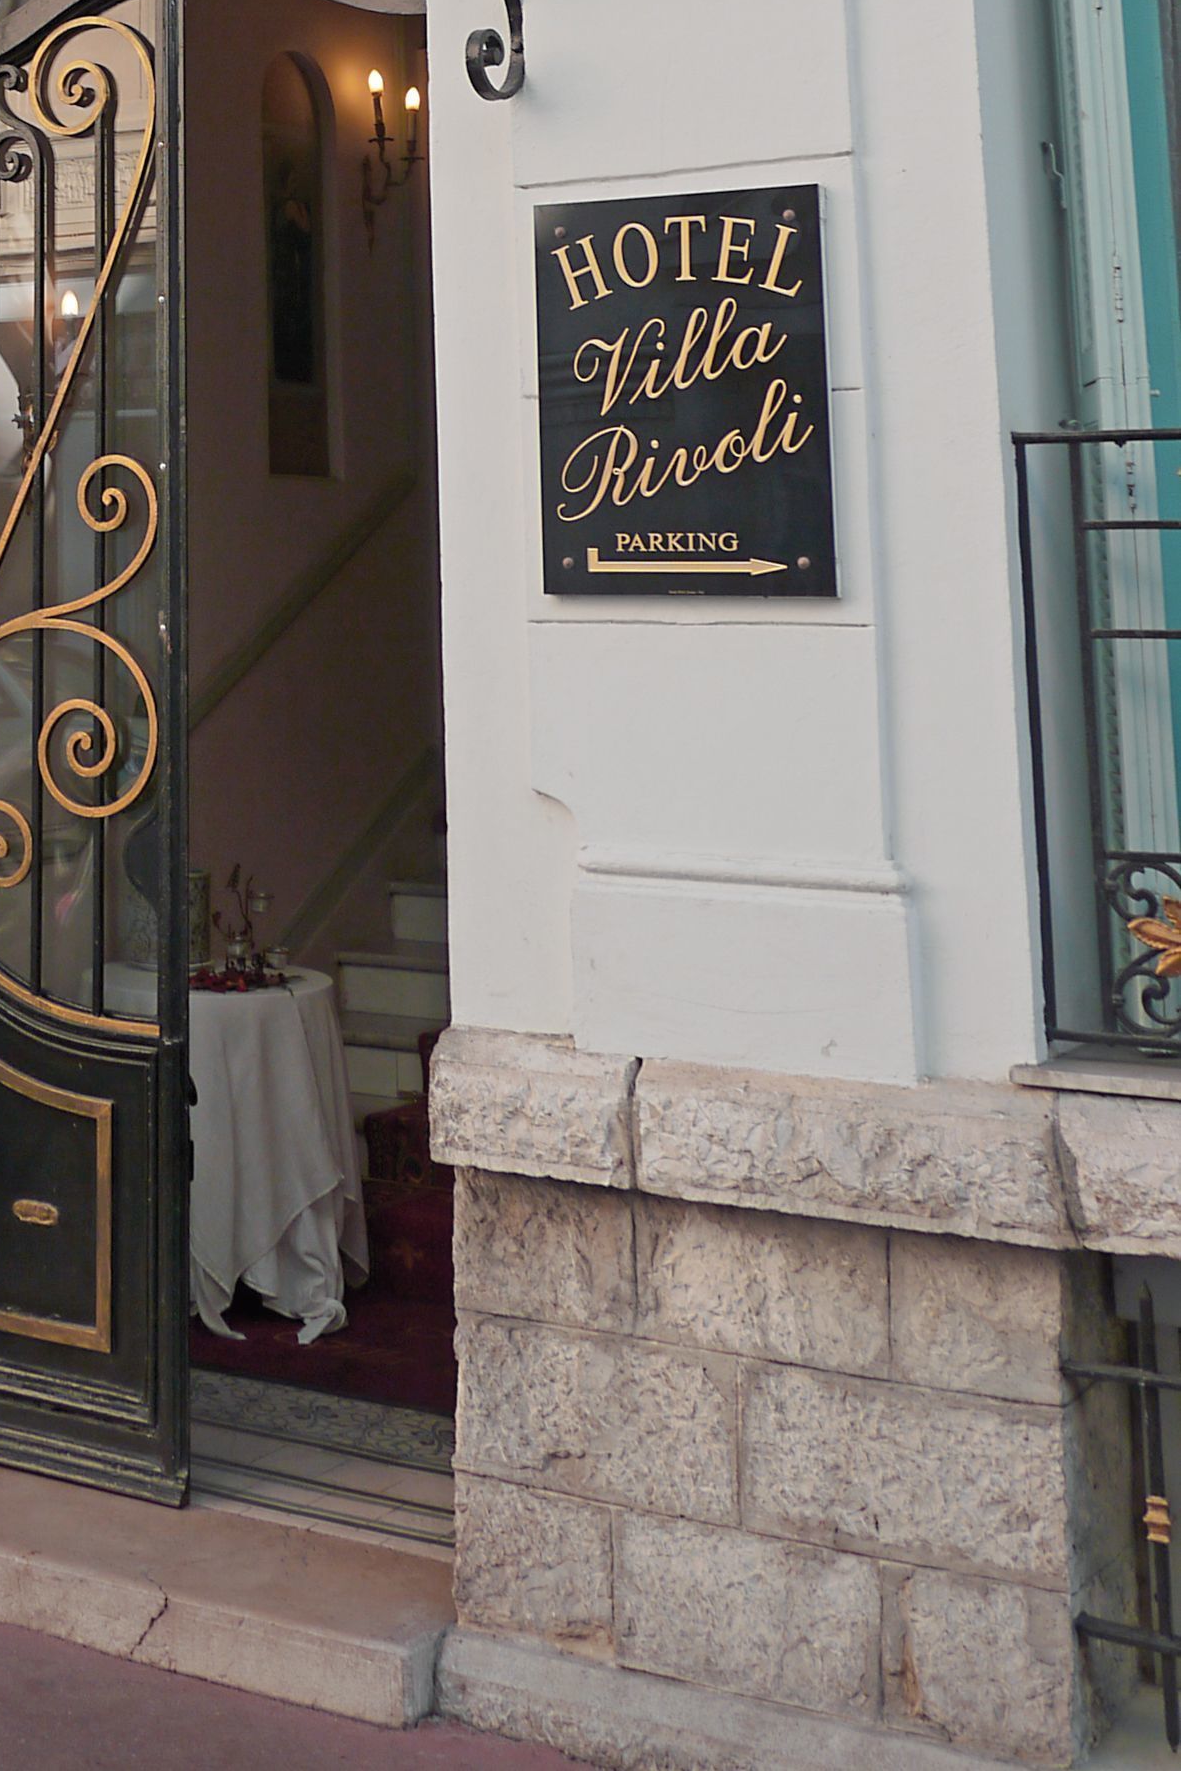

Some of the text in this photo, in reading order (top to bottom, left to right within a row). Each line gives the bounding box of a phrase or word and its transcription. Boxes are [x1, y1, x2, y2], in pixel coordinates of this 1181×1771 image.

[551, 214, 802, 310] HOTEL
[574, 298, 787, 416] Villa
[557, 379, 813, 521] Rivoli
[615, 532, 739, 552] PARKING
